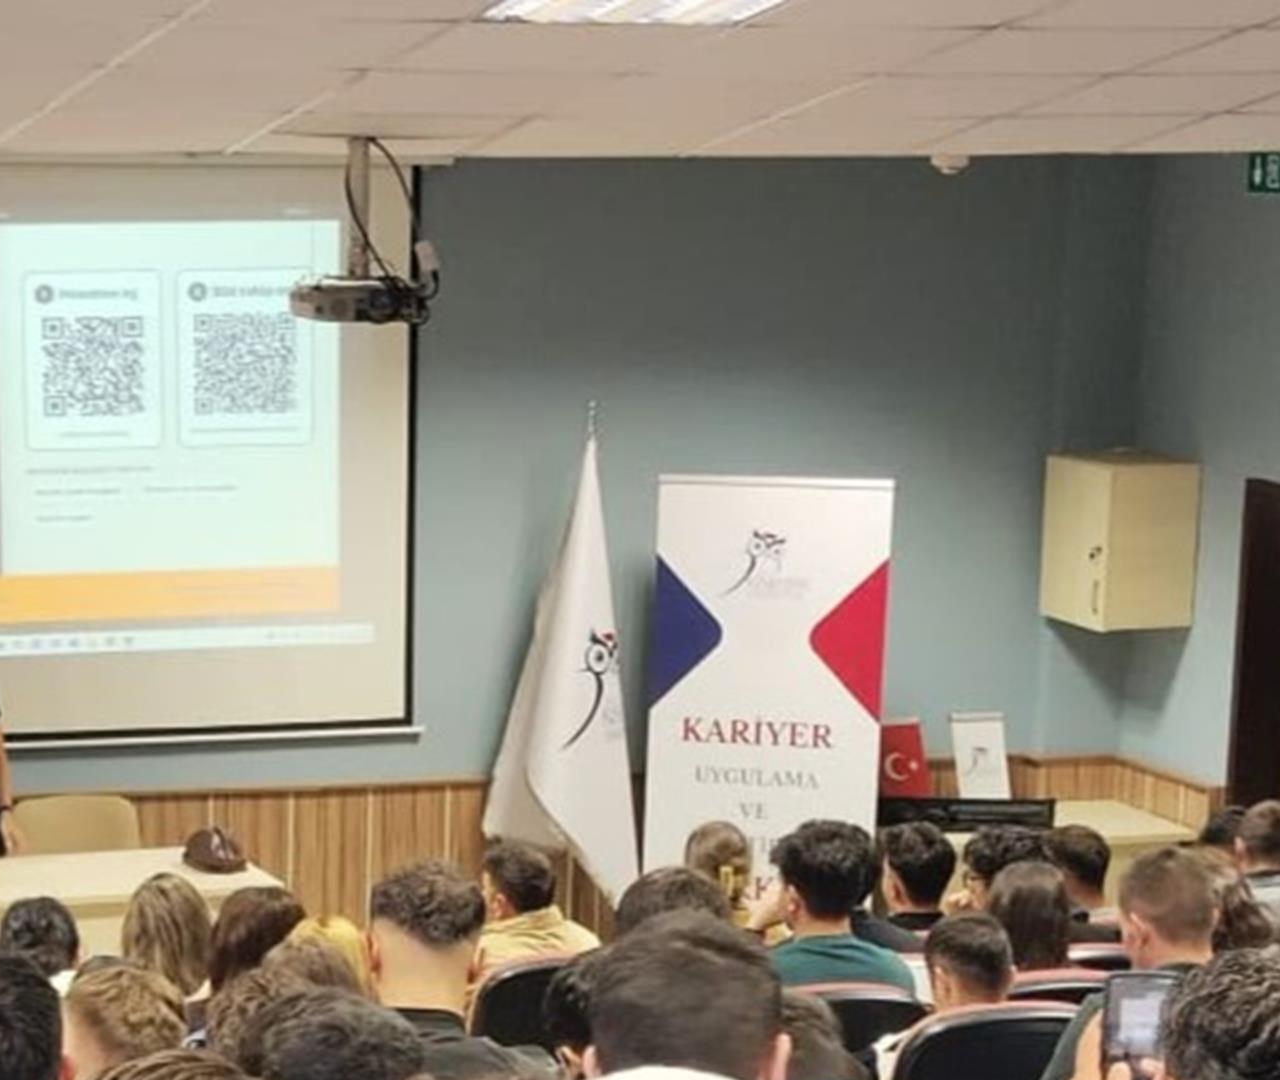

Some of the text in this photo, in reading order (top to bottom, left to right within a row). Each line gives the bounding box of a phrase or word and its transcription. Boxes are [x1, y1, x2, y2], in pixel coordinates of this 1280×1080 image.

[682, 715, 834, 749] KARİYER
[694, 765, 819, 789] UYGULAMA
[739, 802, 767, 819] VE
